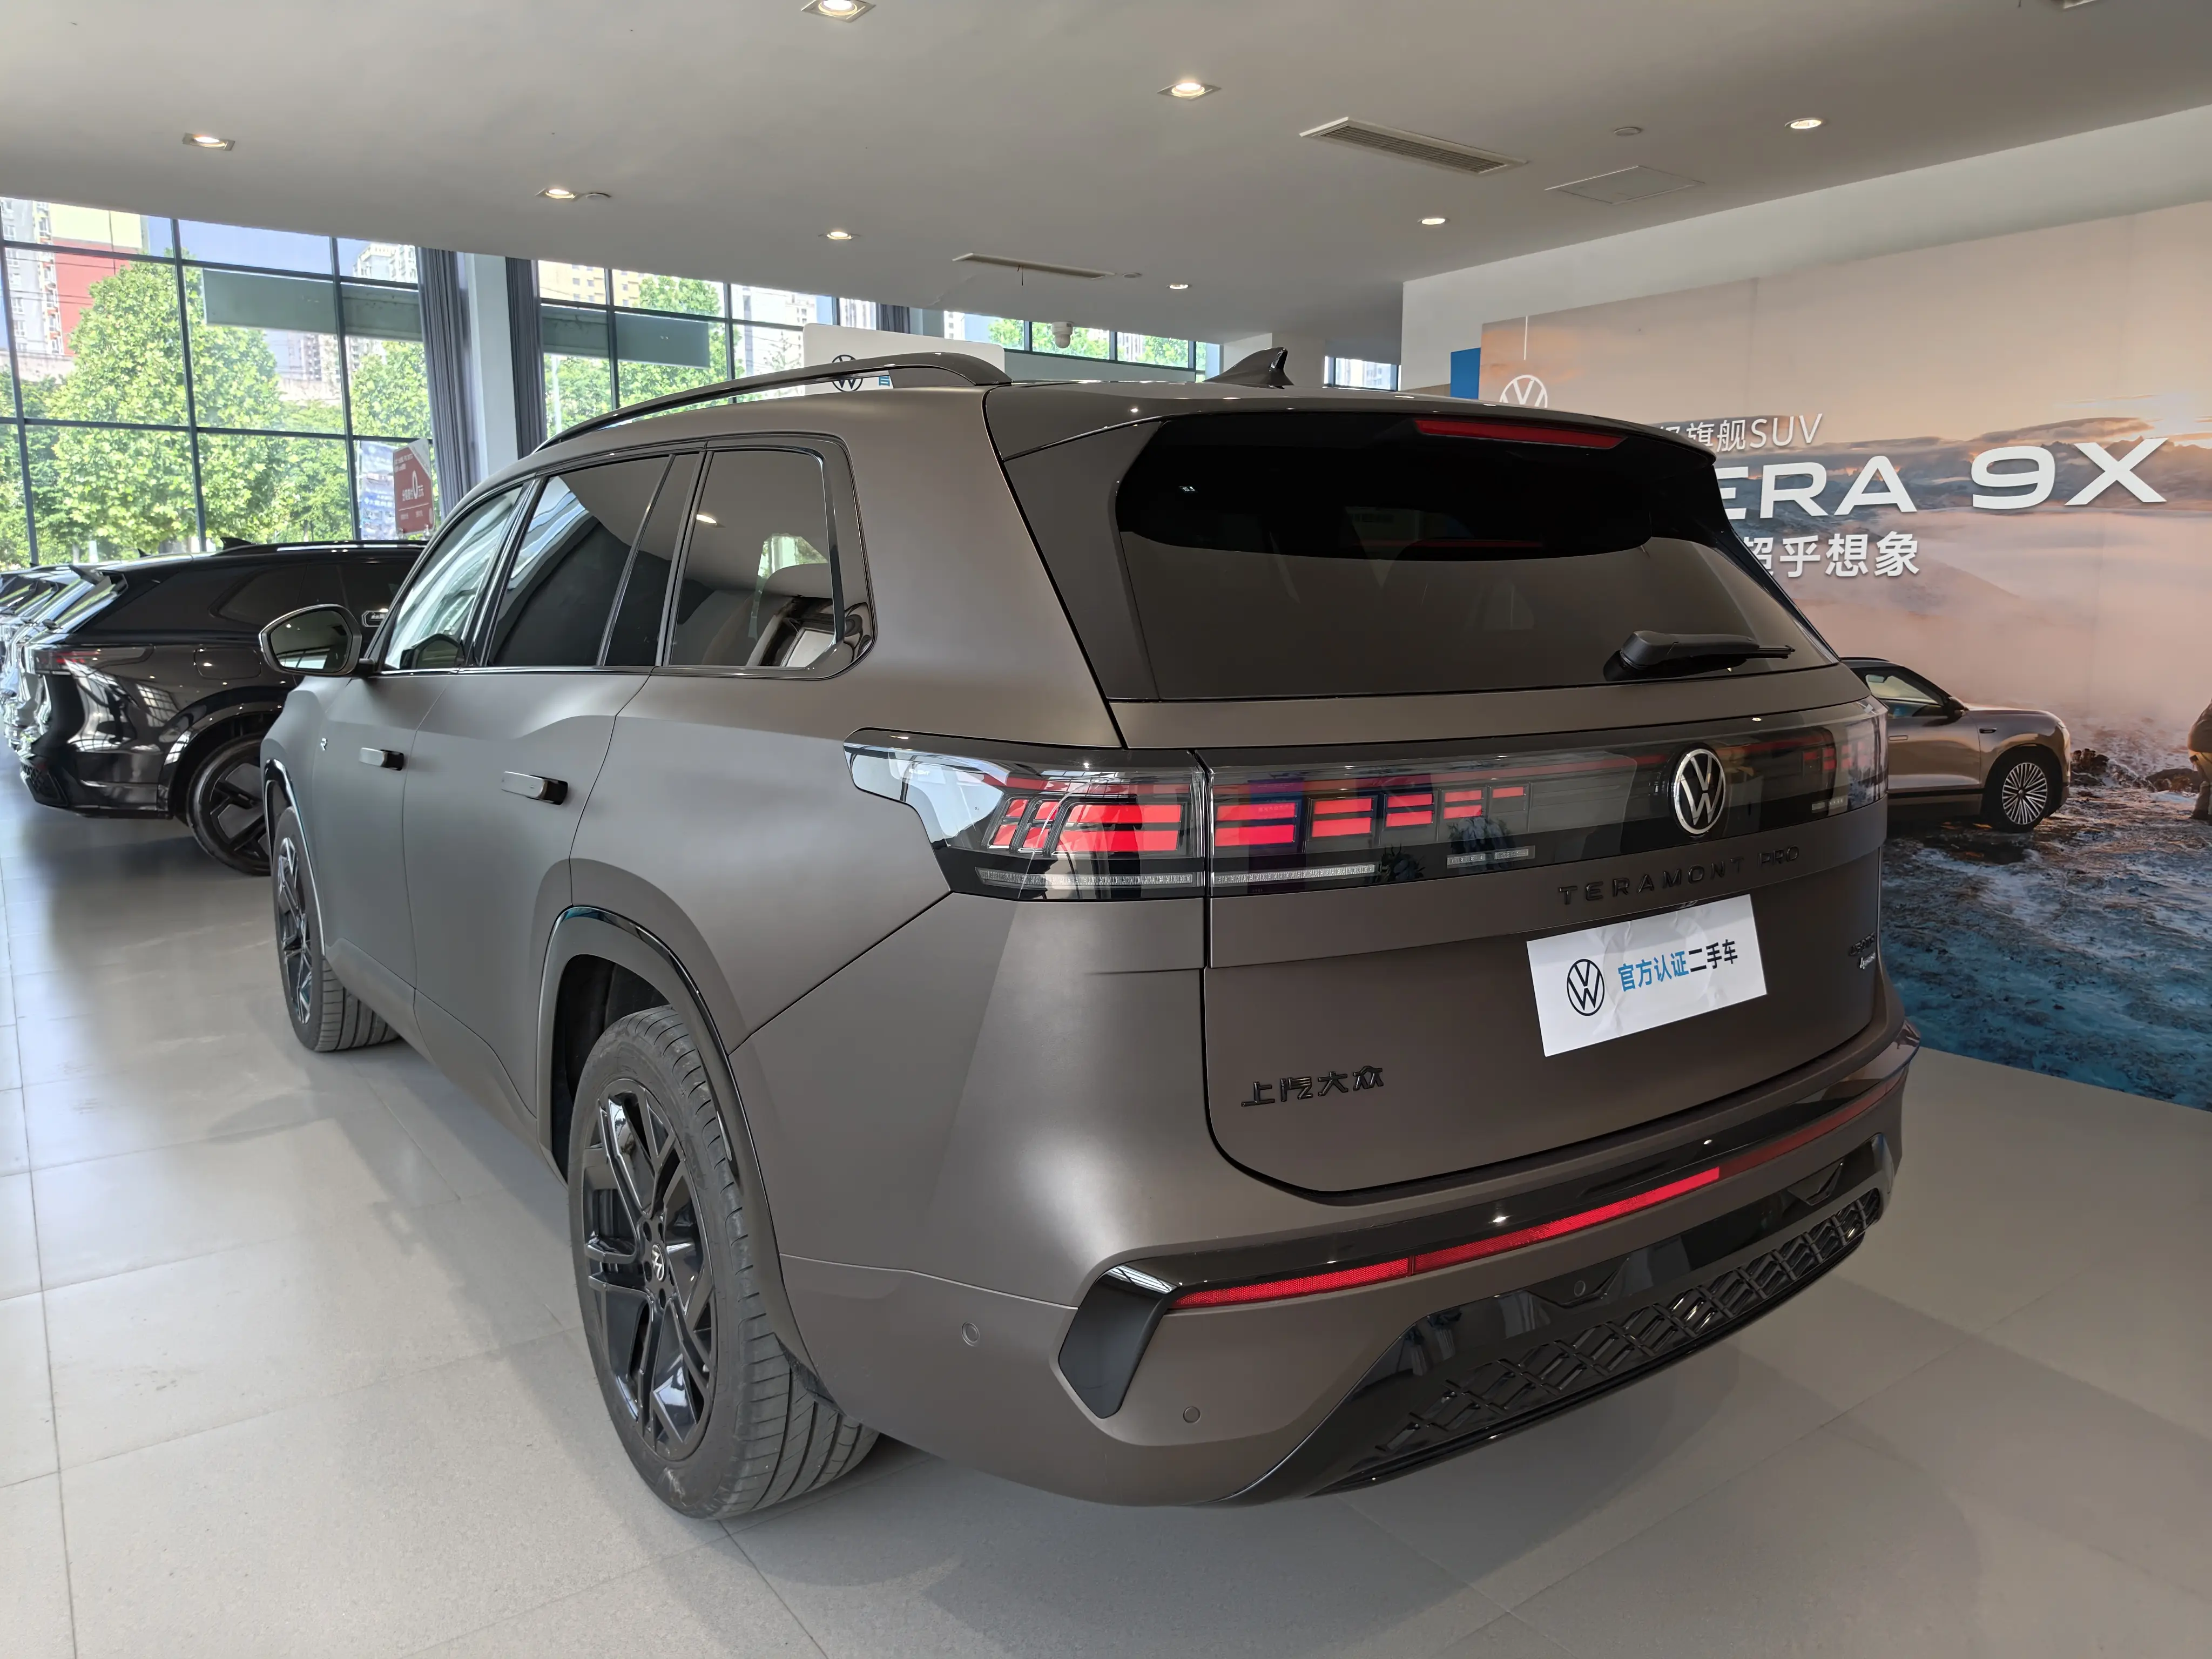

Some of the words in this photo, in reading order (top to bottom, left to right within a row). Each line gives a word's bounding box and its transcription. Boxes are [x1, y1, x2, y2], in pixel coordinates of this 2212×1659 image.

[1971, 437, 2168, 509] 9X
[1559, 857, 1744, 905] TERAMONT
[1757, 845, 1800, 869] PRO
[1617, 939, 1738, 992] 官方认证二手车
[1241, 1065, 1384, 1107] 上汽大众
